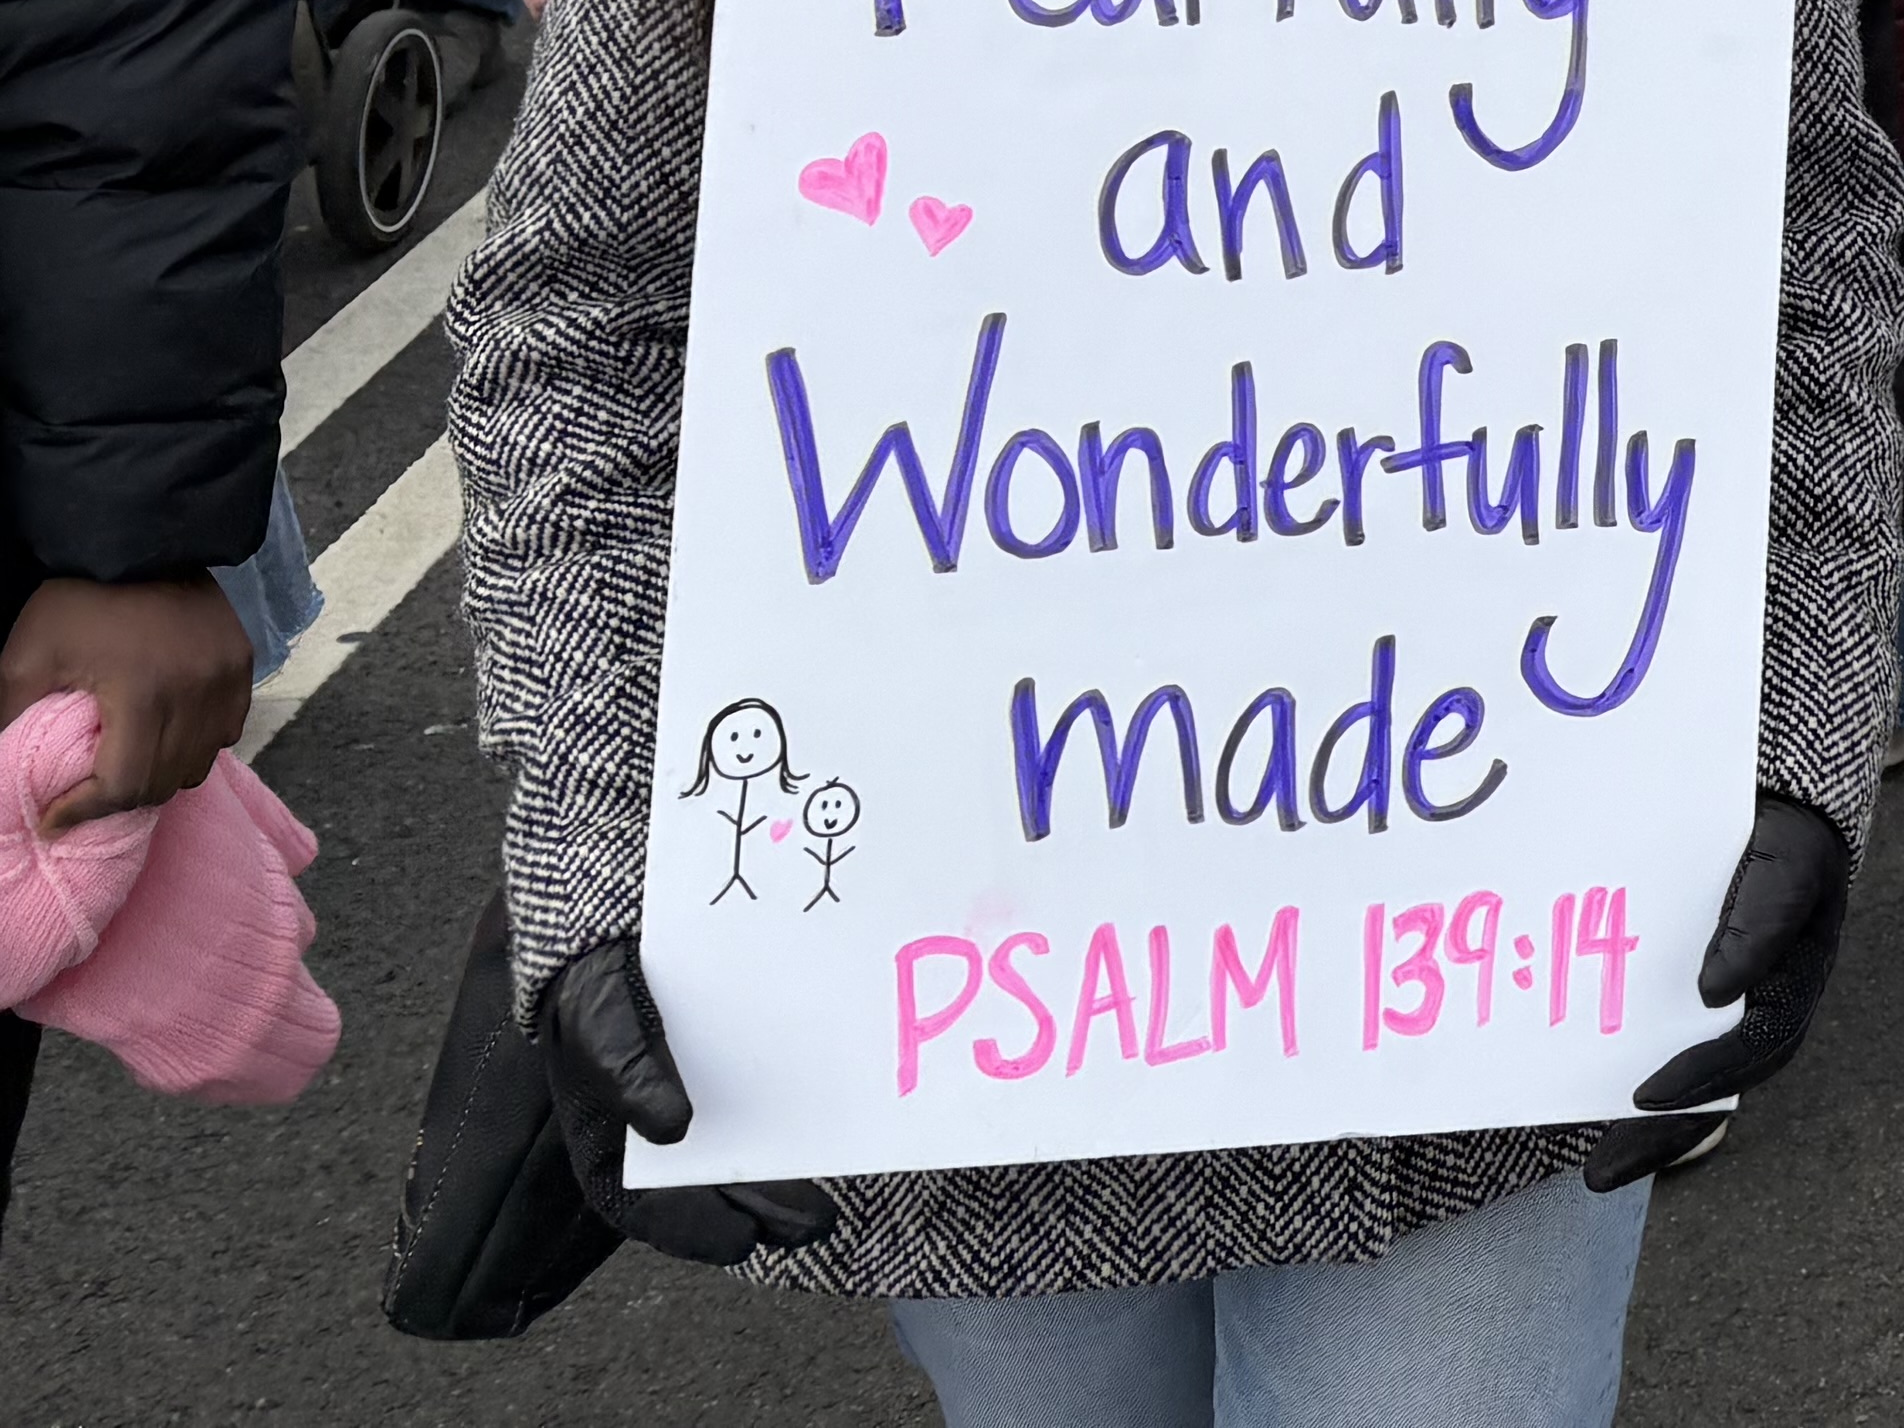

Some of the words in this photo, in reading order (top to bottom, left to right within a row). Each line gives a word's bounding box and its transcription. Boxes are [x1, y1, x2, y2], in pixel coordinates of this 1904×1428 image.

[1098, 90, 1405, 282] and
[764, 311, 1698, 719] Wonderfully
[1011, 633, 1509, 844] made
[894, 902, 1303, 1098] PSALM
[1361, 883, 1641, 1053] 139:14
